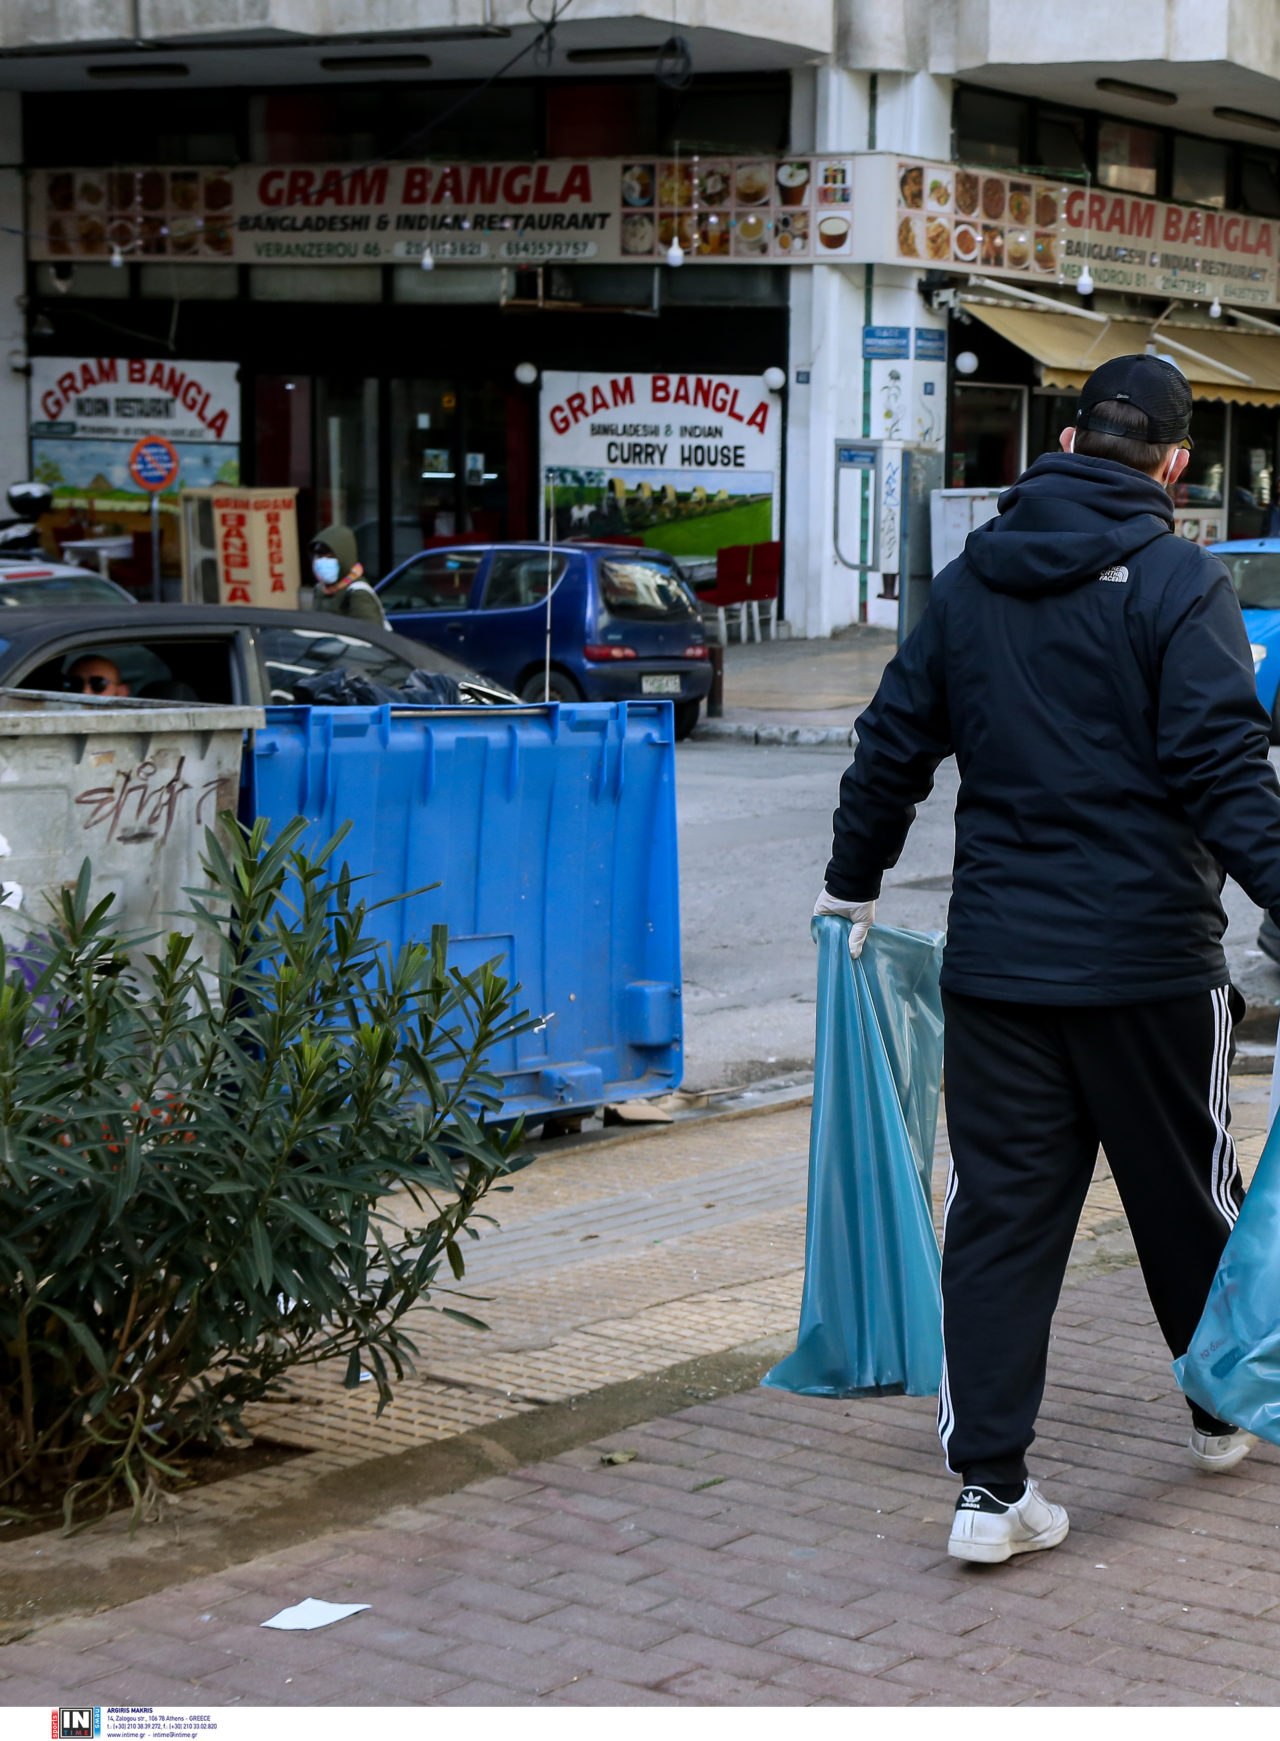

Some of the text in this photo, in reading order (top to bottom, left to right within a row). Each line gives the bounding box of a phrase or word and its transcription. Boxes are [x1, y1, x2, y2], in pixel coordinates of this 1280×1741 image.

[258, 165, 592, 206] GRAM BANGLA
[239, 212, 611, 231] BANGLADESHI & INDIAN RESTAURANT
[1065, 190, 1273, 257] GRAM BANGLA
[254, 241, 359, 258] VERANZEROU
[362, 241, 381, 257] 46
[1065, 239, 1146, 266] BANGLADESHI
[1160, 253, 1199, 273] INDIAN
[1200, 259, 1268, 282] RESTAURANT
[42, 356, 229, 439] GRAM BANGLA
[549, 374, 769, 435] GRAM BANGLA
[590, 422, 660, 438] BANGLADESHI
[680, 424, 723, 439] INDIAN
[606, 441, 746, 468] CURRY HOUSE
[221, 512, 251, 604] BANGLA
[266, 511, 285, 593] BANGLA
